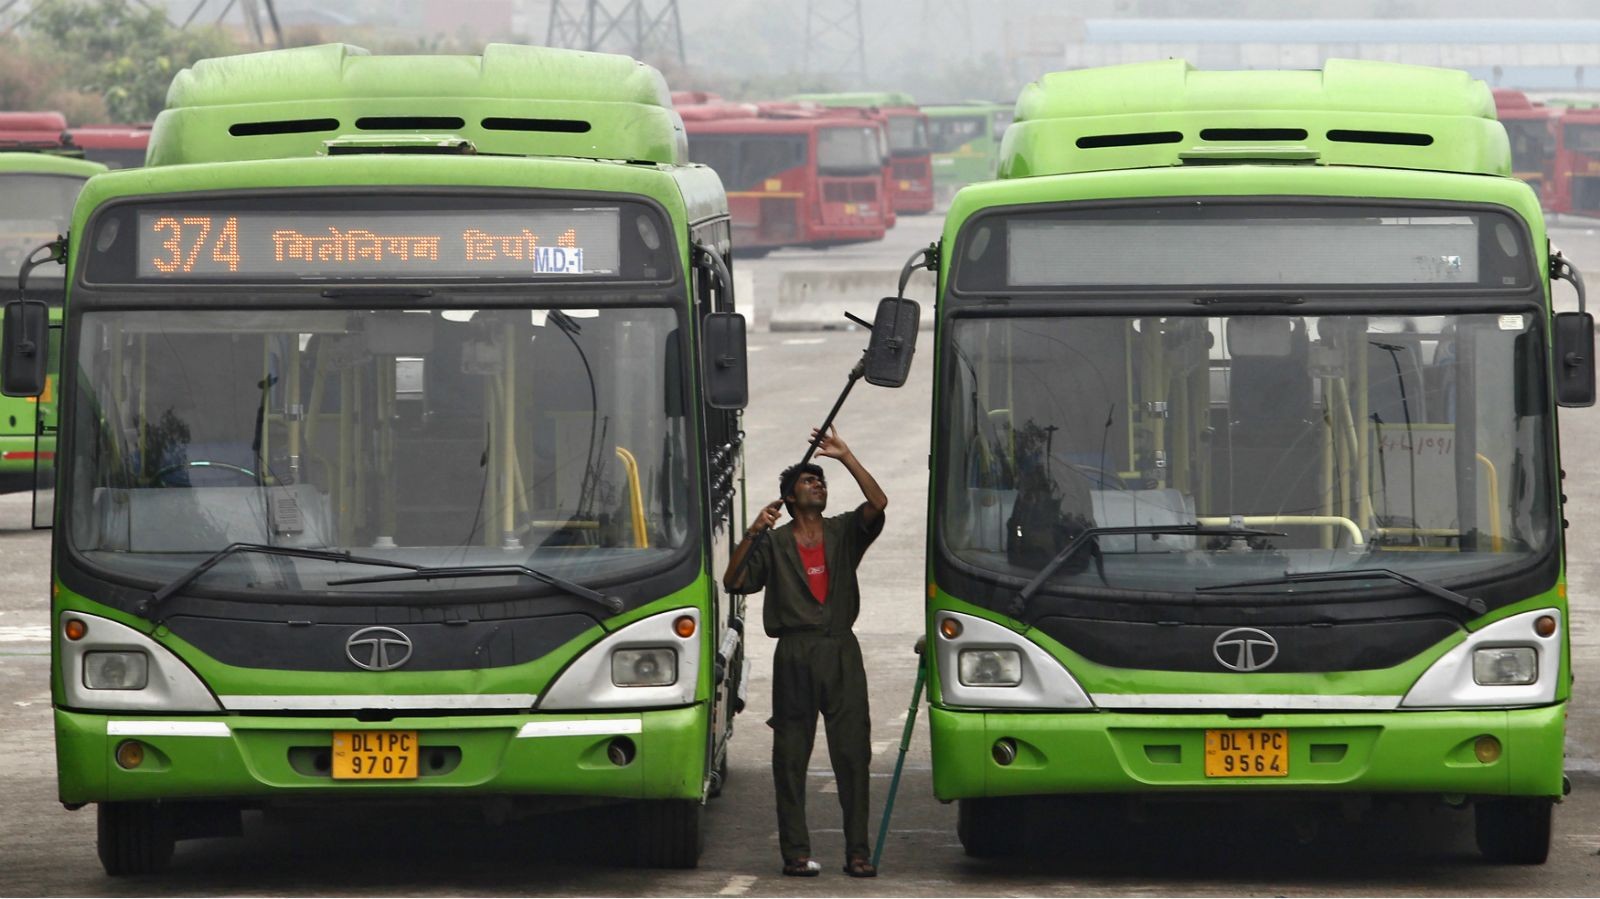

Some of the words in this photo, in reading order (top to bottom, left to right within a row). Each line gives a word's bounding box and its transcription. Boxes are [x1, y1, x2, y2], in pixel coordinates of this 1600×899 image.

[153, 217, 240, 272] 374
[535, 248, 582, 273] M.D.-1
[352, 756, 408, 774] 9707
[1224, 754, 1280, 772] 9564
